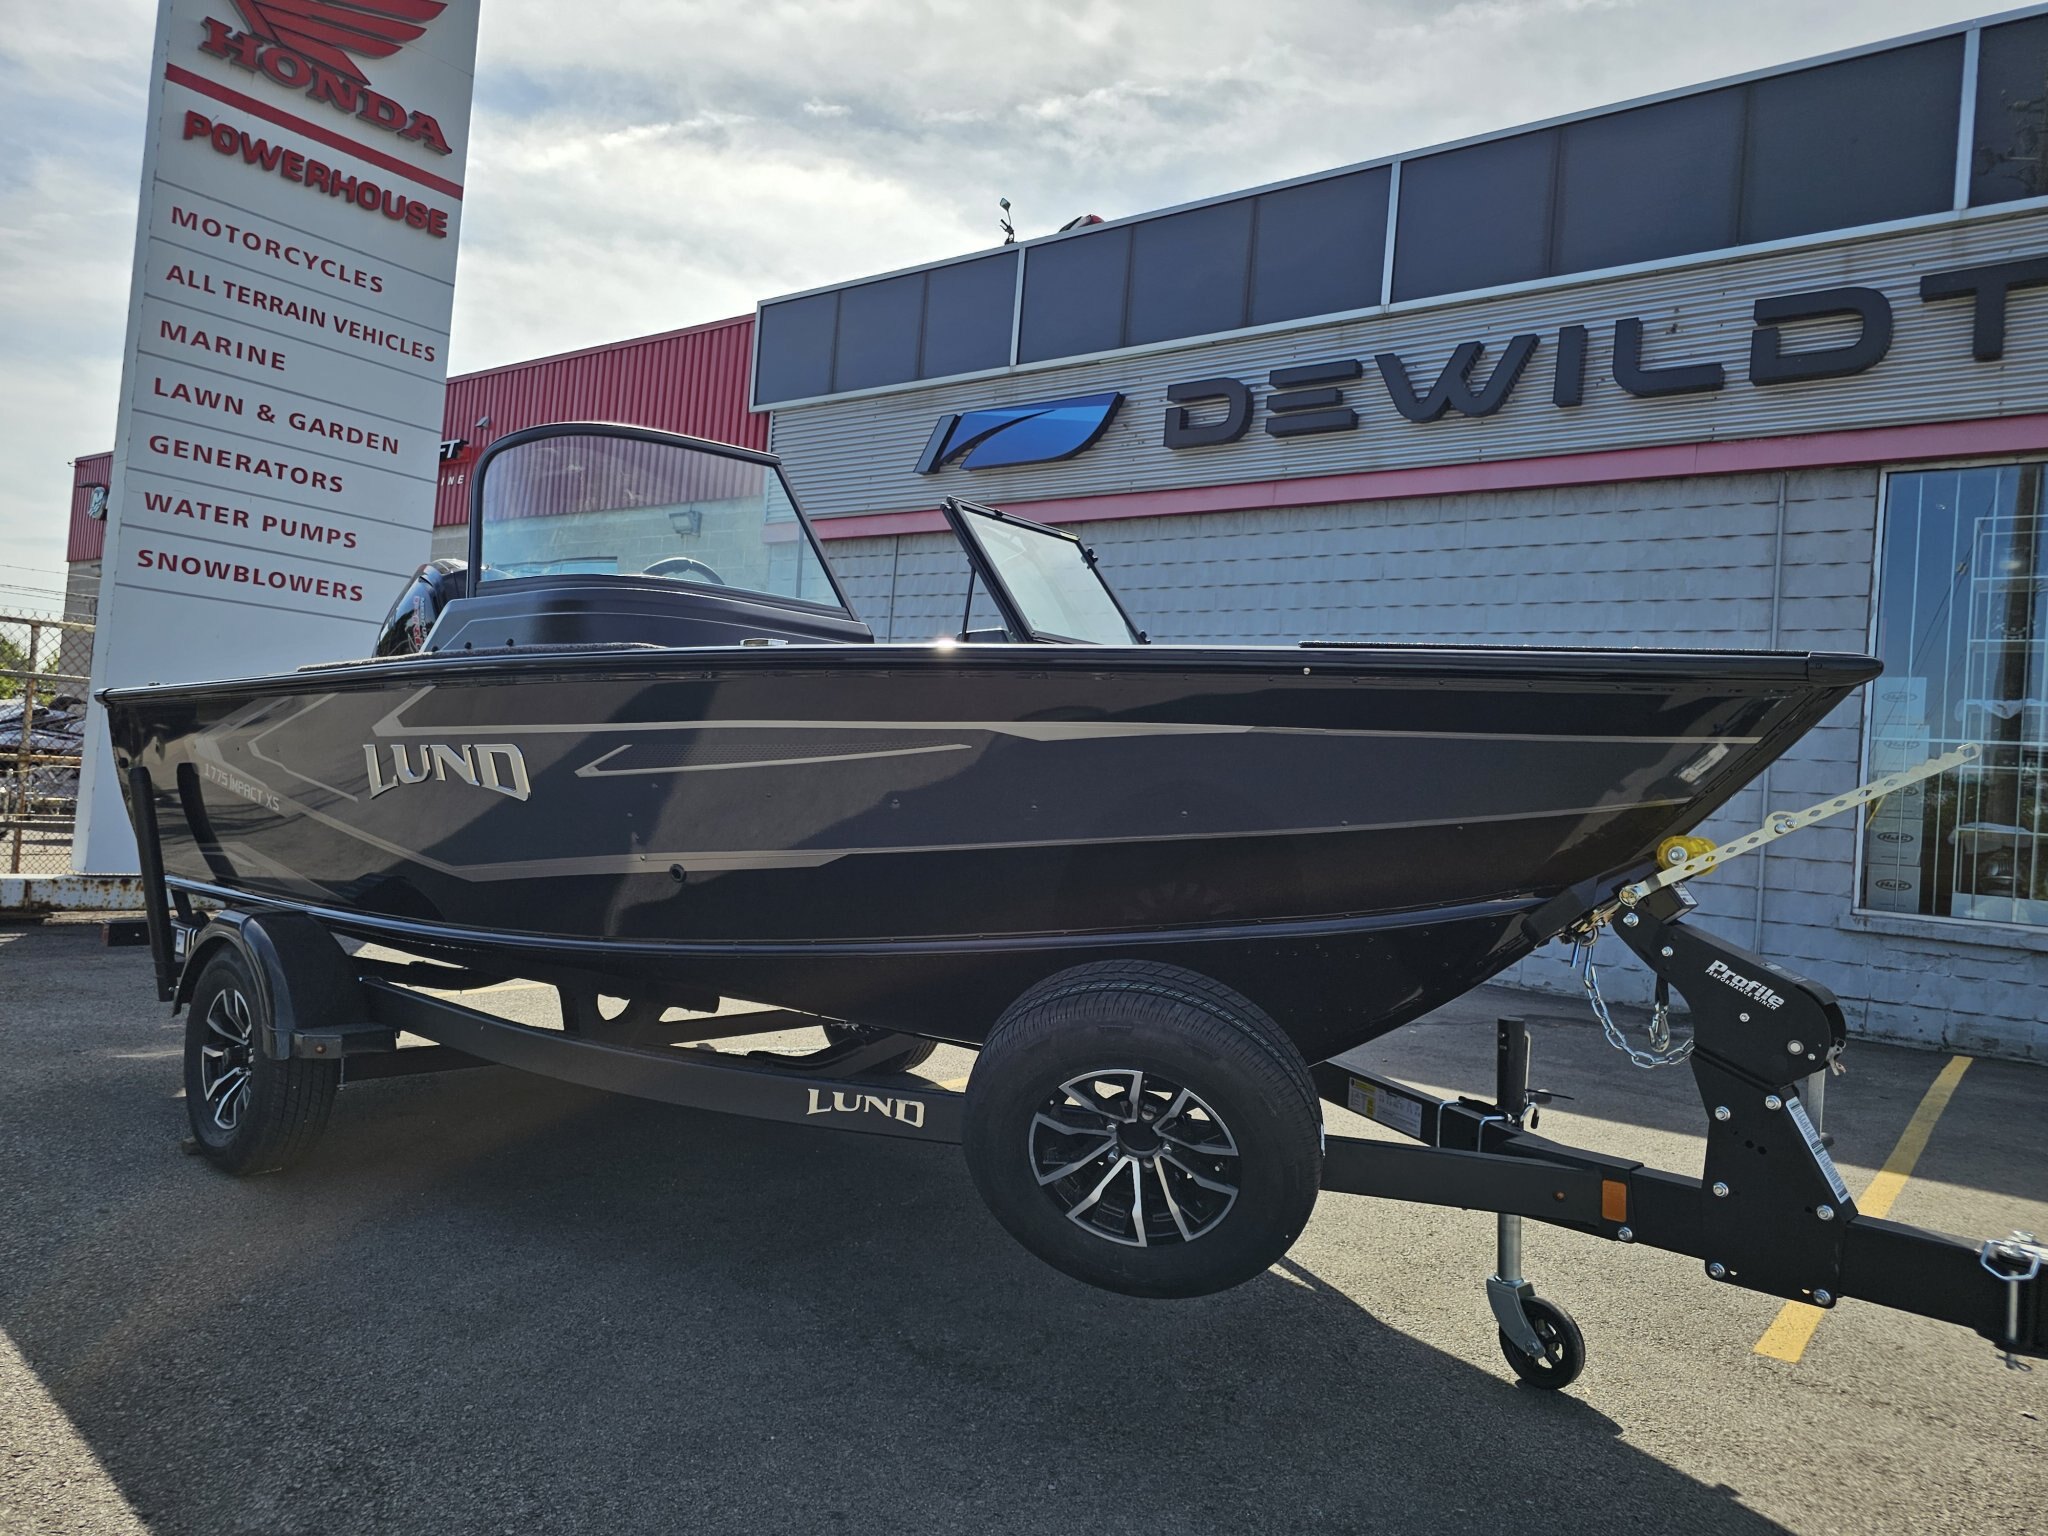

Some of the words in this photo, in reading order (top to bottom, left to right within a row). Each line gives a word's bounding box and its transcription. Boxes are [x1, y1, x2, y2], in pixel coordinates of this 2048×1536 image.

[199, 16, 453, 156] HONDA
[183, 110, 448, 239] POWERHOUSE
[171, 206, 384, 293] MOTORCYCLES
[166, 265, 216, 294] ALL
[223, 280, 326, 327] TERRAIN
[333, 315, 436, 363] VEHICLES
[160, 320, 286, 371] MARINE
[1163, 257, 2048, 451] DEWILDT
[154, 377, 244, 416] LAWN
[257, 404, 276, 424] &
[288, 412, 399, 455] GARDEN
[149, 435, 344, 493] GENERATORS
[144, 492, 249, 529] WATER
[262, 515, 357, 549] PUMPS
[137, 549, 363, 602] SNOWBLOWERS
[204, 763, 229, 786] 1775
[266, 793, 280, 811] XS
[362, 743, 532, 802] LUND
[1705, 969, 1753, 997] PERFORMANCE
[1753, 995, 1777, 1011] WINCH
[1706, 960, 1785, 1008] Profile
[806, 1088, 925, 1128] LUND
